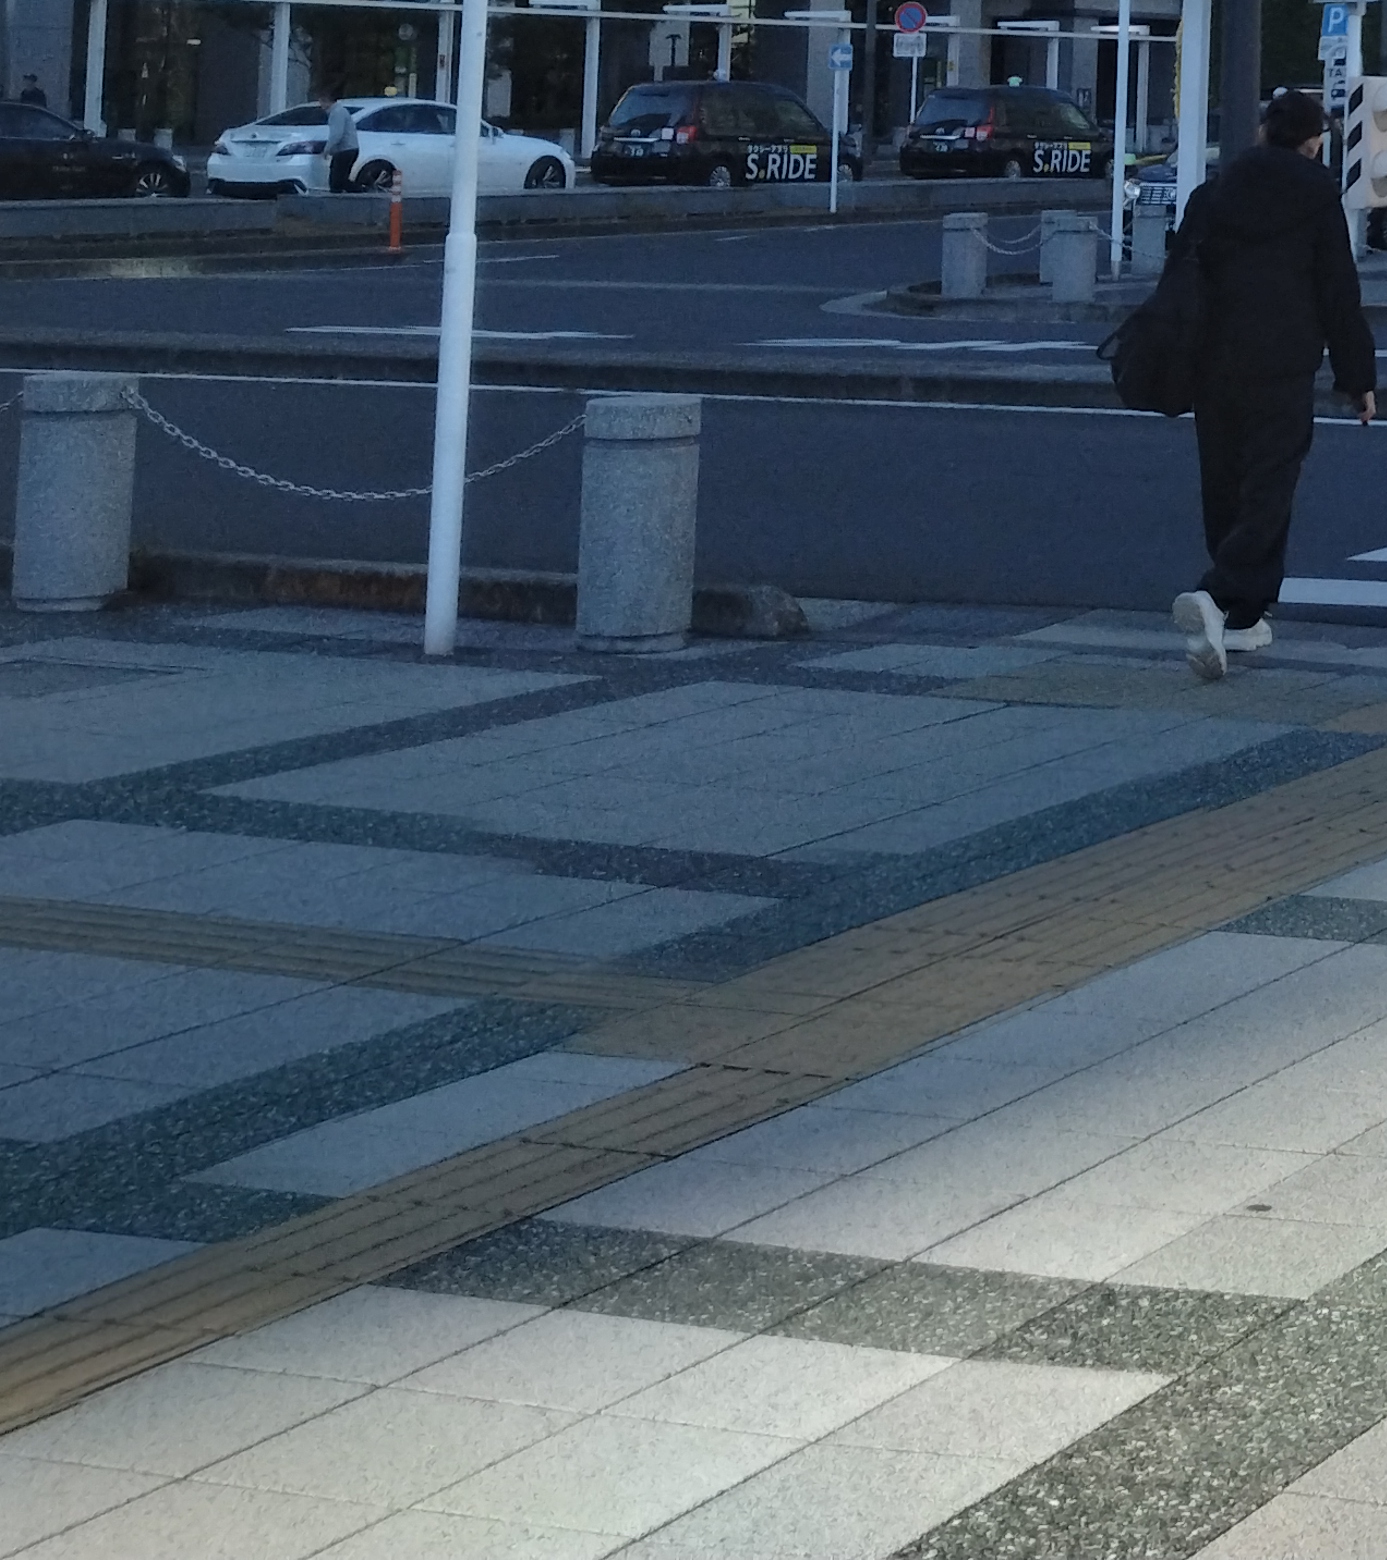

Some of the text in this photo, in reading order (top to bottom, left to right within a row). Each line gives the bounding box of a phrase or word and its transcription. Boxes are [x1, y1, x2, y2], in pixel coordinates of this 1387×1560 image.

[1327, 6, 1344, 34] P
[745, 153, 817, 180] S.RIDE
[1033, 150, 1092, 174] S.RIDE
